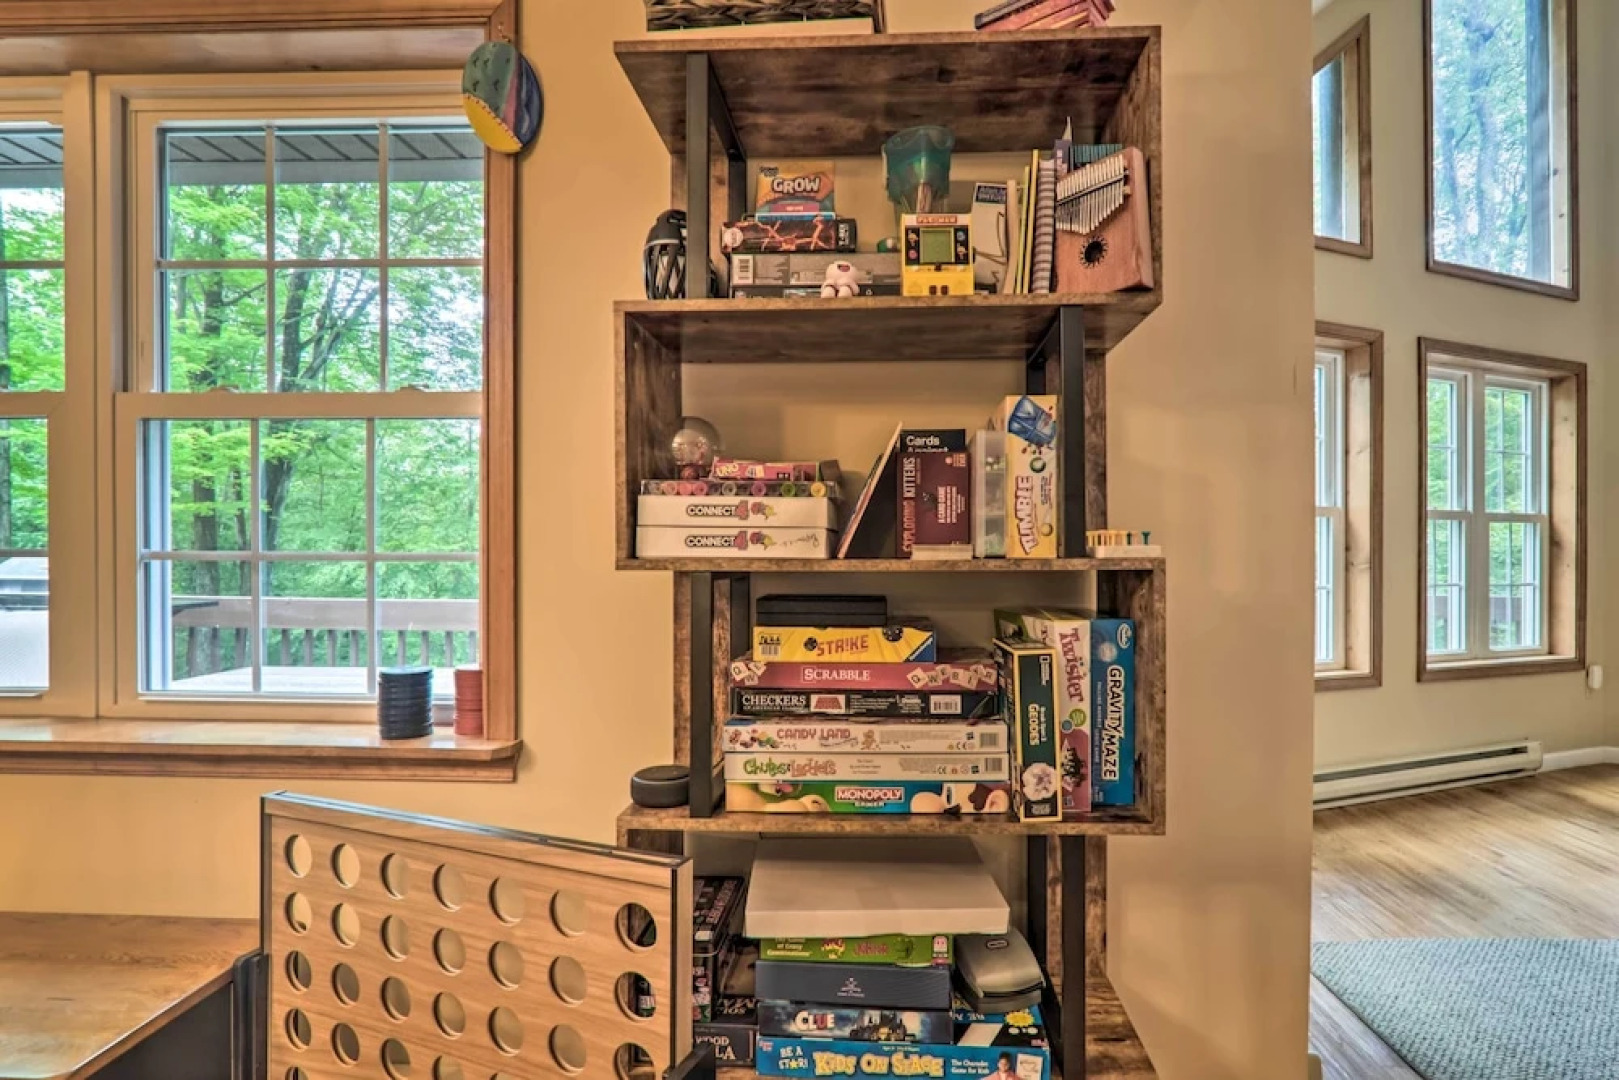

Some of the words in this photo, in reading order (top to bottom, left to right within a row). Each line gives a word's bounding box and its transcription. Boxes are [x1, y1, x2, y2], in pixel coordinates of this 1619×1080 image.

[772, 177, 820, 194] GROW
[906, 435, 940, 446] Cards
[902, 457, 916, 498] KITTENS
[686, 505, 736, 516] CONNECT
[1015, 476, 1037, 555] TUMBLE
[685, 535, 735, 547] CONNECT
[1059, 628, 1084, 702] Twister
[804, 668, 870, 681] SCRABBLE
[742, 693, 807, 705] CHECKERS
[1107, 668, 1123, 733] GRAVITY
[777, 728, 816, 739] CANDY
[820, 728, 850, 740] LAND
[1103, 733, 1118, 779] MAZE
[837, 789, 902, 801] MONOPOLY
[794, 1010, 836, 1031] CLUE
